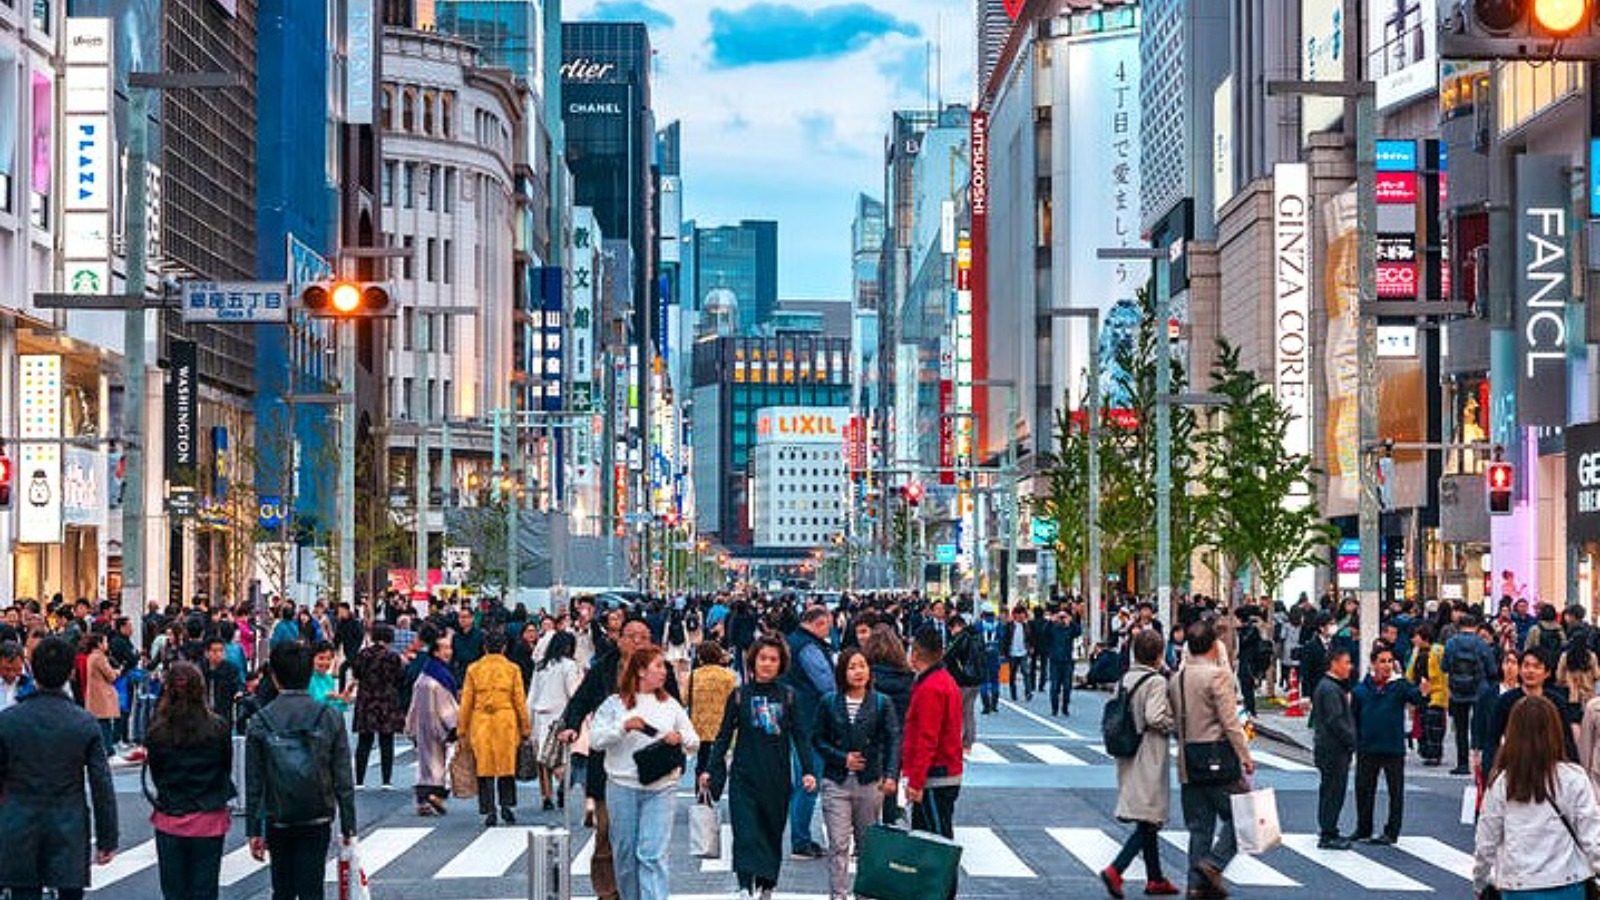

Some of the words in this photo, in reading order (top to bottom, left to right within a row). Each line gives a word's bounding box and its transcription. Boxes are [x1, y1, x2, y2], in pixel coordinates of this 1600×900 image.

[559, 58, 614, 79] rtier
[569, 103, 621, 113] CHANEL
[79, 125, 95, 200] PLAZA
[973, 118, 985, 215] MITSUKOSHI
[1279, 194, 1304, 299] GINZA
[1526, 208, 1566, 378] FANCL
[1279, 310, 1304, 399] CORE
[177, 365, 190, 464] WASHINGTON
[779, 415, 837, 434] LIXIL
[259, 503, 289, 520] GU
